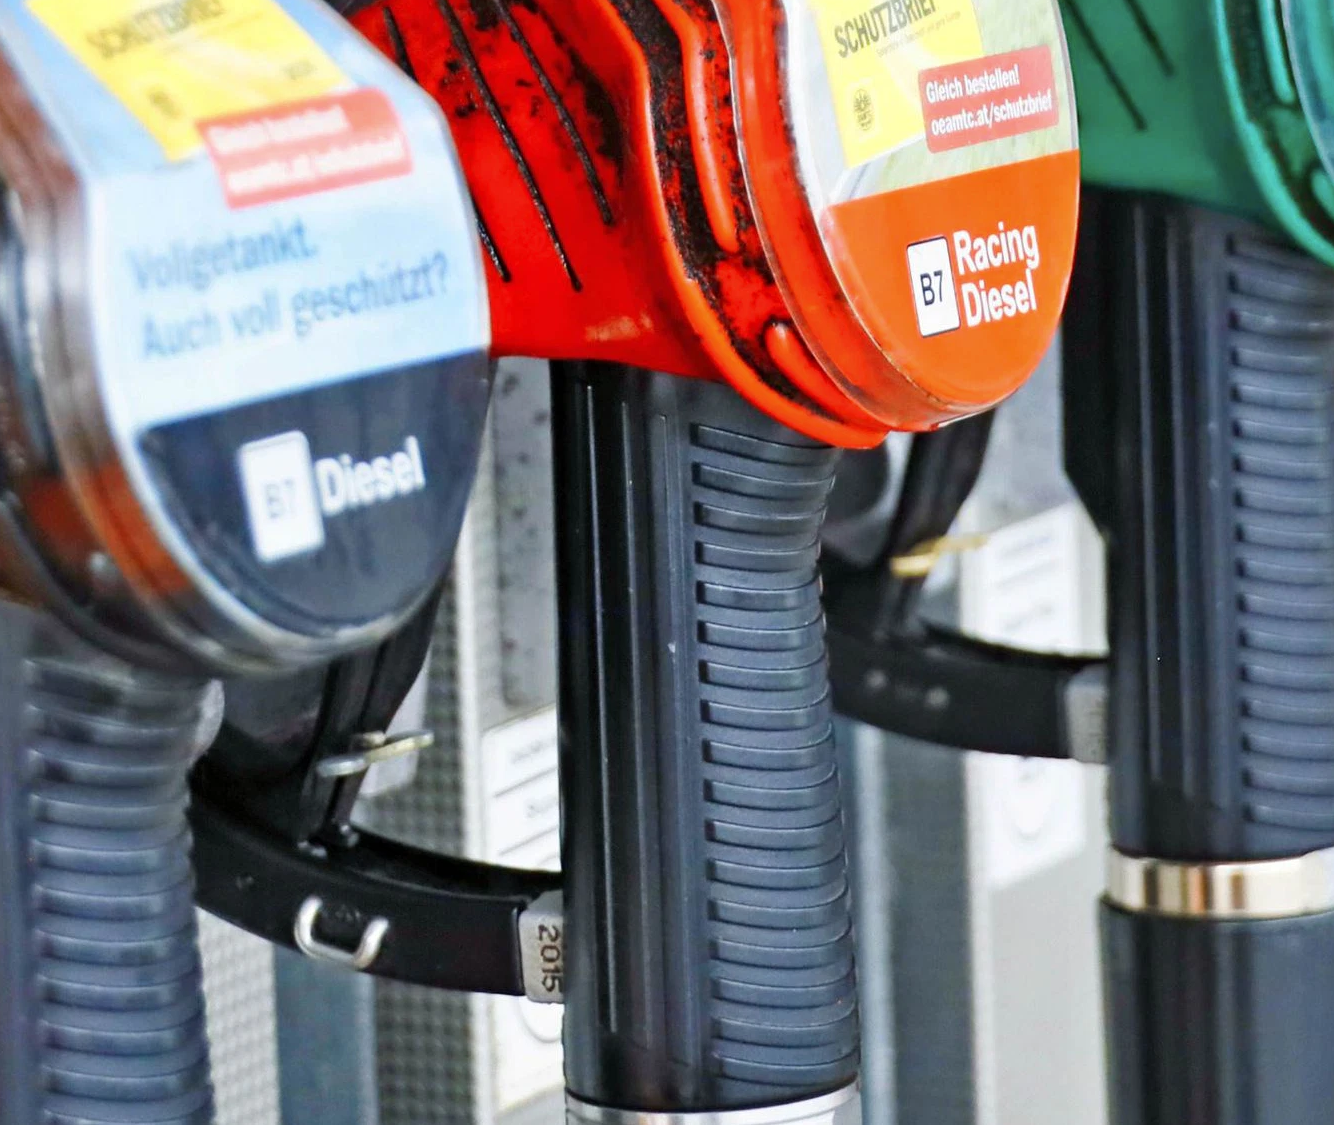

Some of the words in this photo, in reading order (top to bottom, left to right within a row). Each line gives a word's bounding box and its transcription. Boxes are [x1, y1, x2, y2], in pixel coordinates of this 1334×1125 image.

[925, 75, 964, 104] Gleich
[964, 63, 1020, 96] bestellen!
[930, 88, 1053, 136] oeamtc.at/schutzbrief
[129, 219, 316, 290] Vollgetankt.
[953, 221, 1040, 276] Racing
[142, 307, 222, 359] Auch
[229, 286, 282, 339] voll
[291, 249, 450, 341] geschützt?
[920, 270, 943, 306] B7
[961, 268, 1037, 327] Diesel
[264, 478, 296, 519] B7
[314, 434, 426, 517] Diesel
[538, 924, 563, 993] 2015
